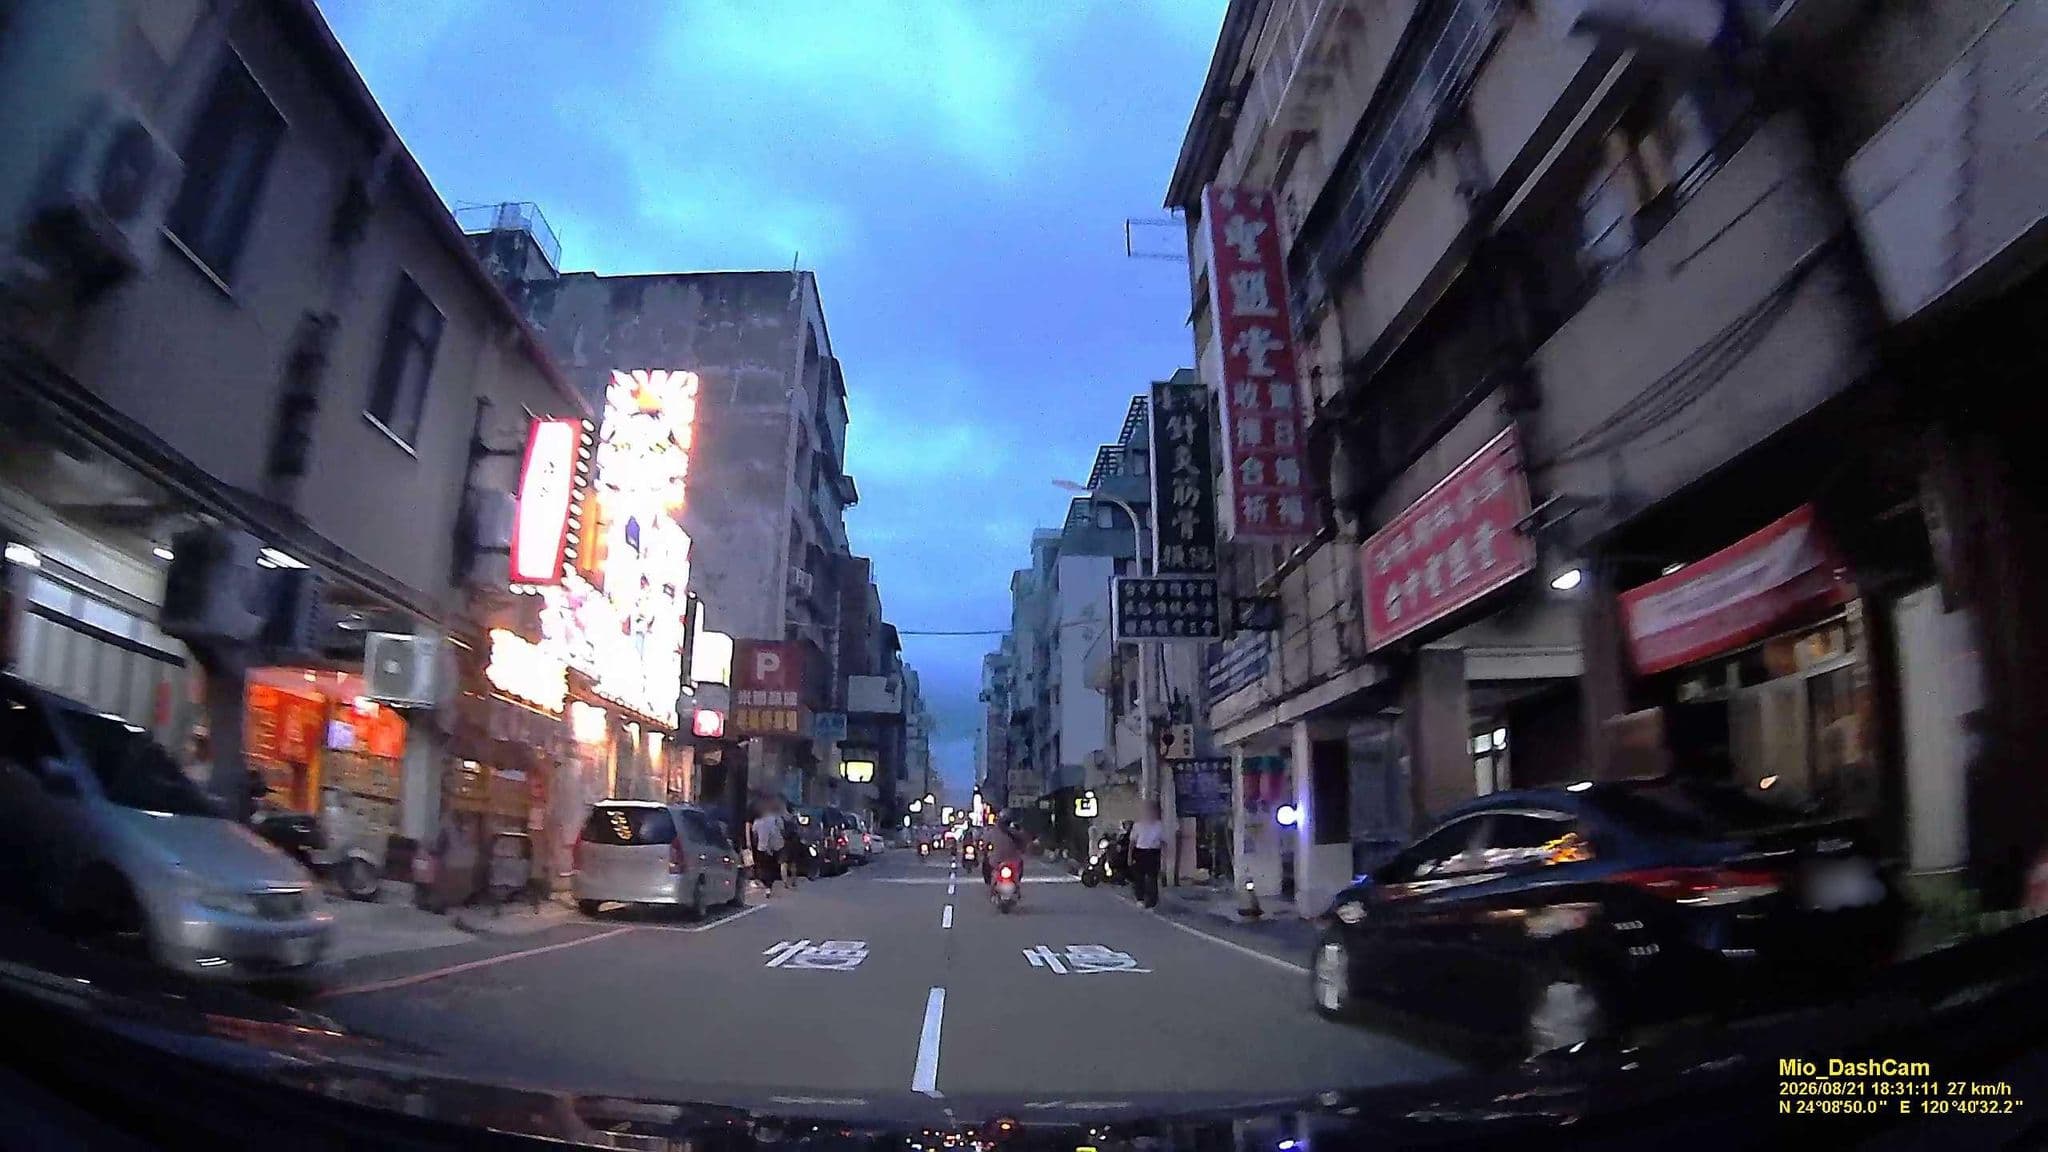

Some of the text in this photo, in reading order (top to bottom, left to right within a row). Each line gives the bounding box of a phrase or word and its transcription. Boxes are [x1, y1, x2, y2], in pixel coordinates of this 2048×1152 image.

[756, 651, 782, 681] P
[761, 938, 870, 971] 慢
[1022, 943, 1153, 975] 慢
